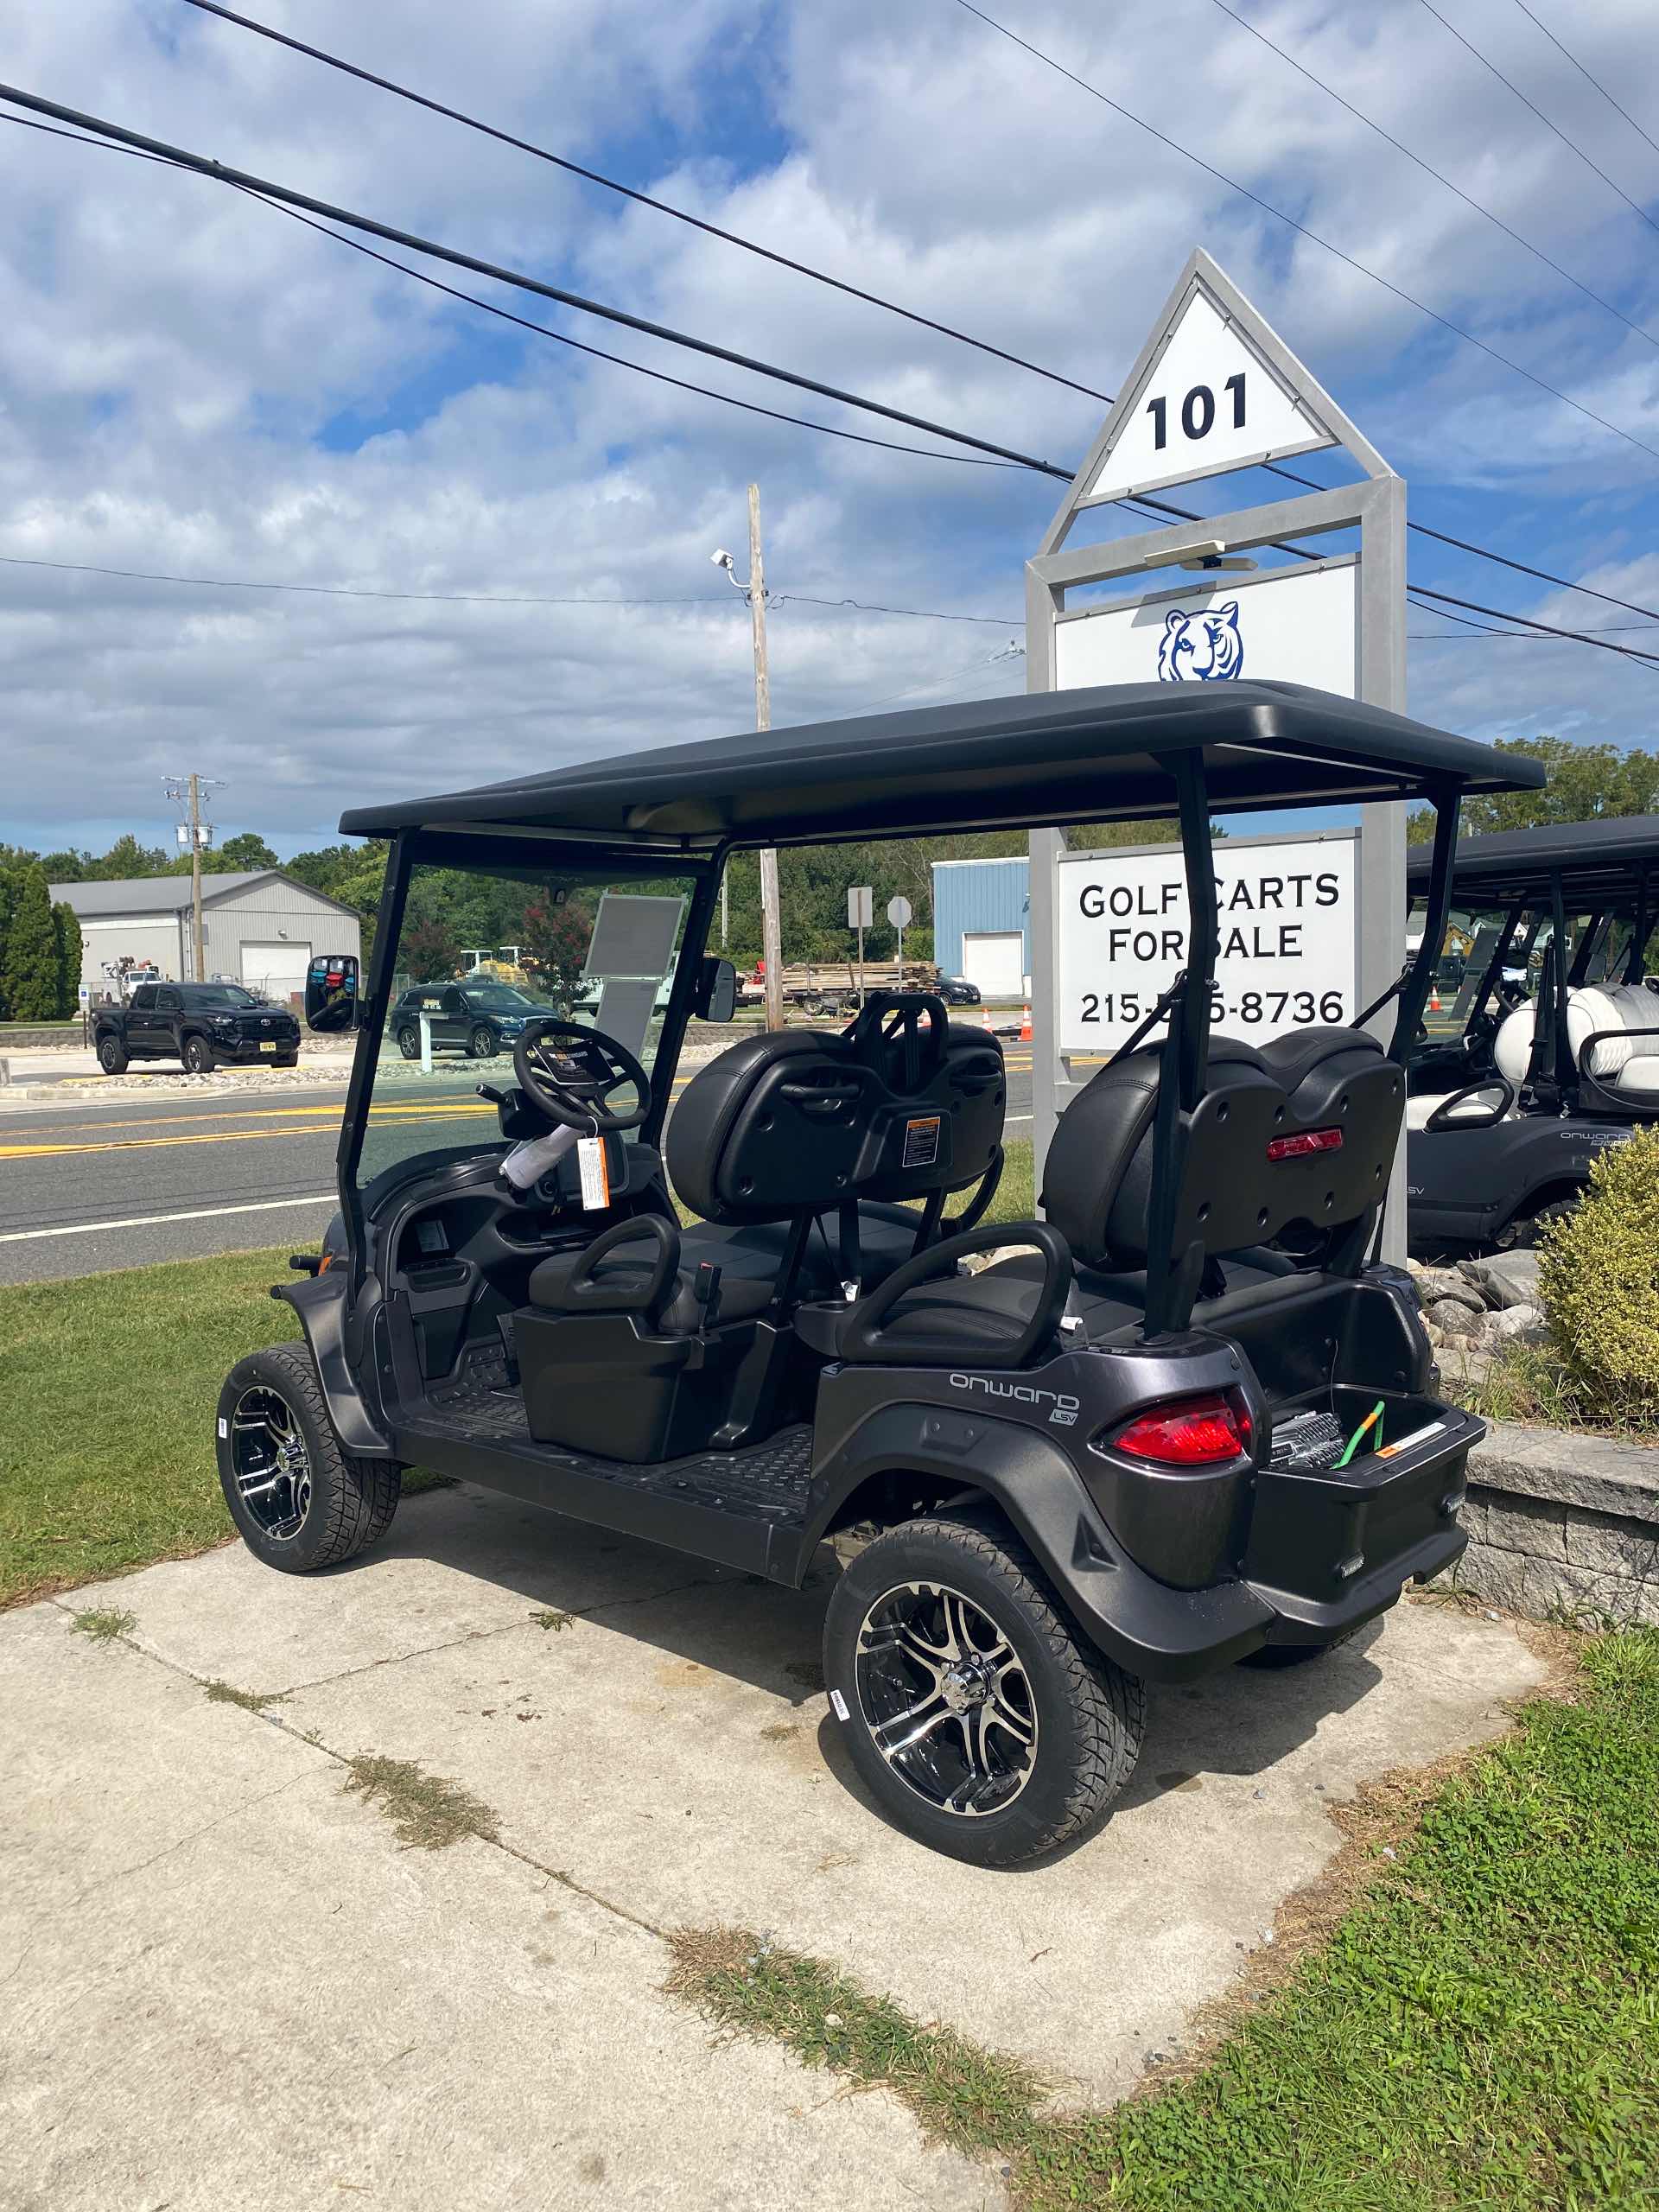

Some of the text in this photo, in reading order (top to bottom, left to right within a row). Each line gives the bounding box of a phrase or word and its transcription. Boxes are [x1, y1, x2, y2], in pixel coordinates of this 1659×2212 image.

[1147, 372, 1246, 450] 101
[1079, 883, 1182, 918] GOLF
[1109, 924, 1302, 962] FOR ALE
[1081, 991, 1344, 1024] 215-5-8736
[1053, 1413, 1077, 1422] LSV
